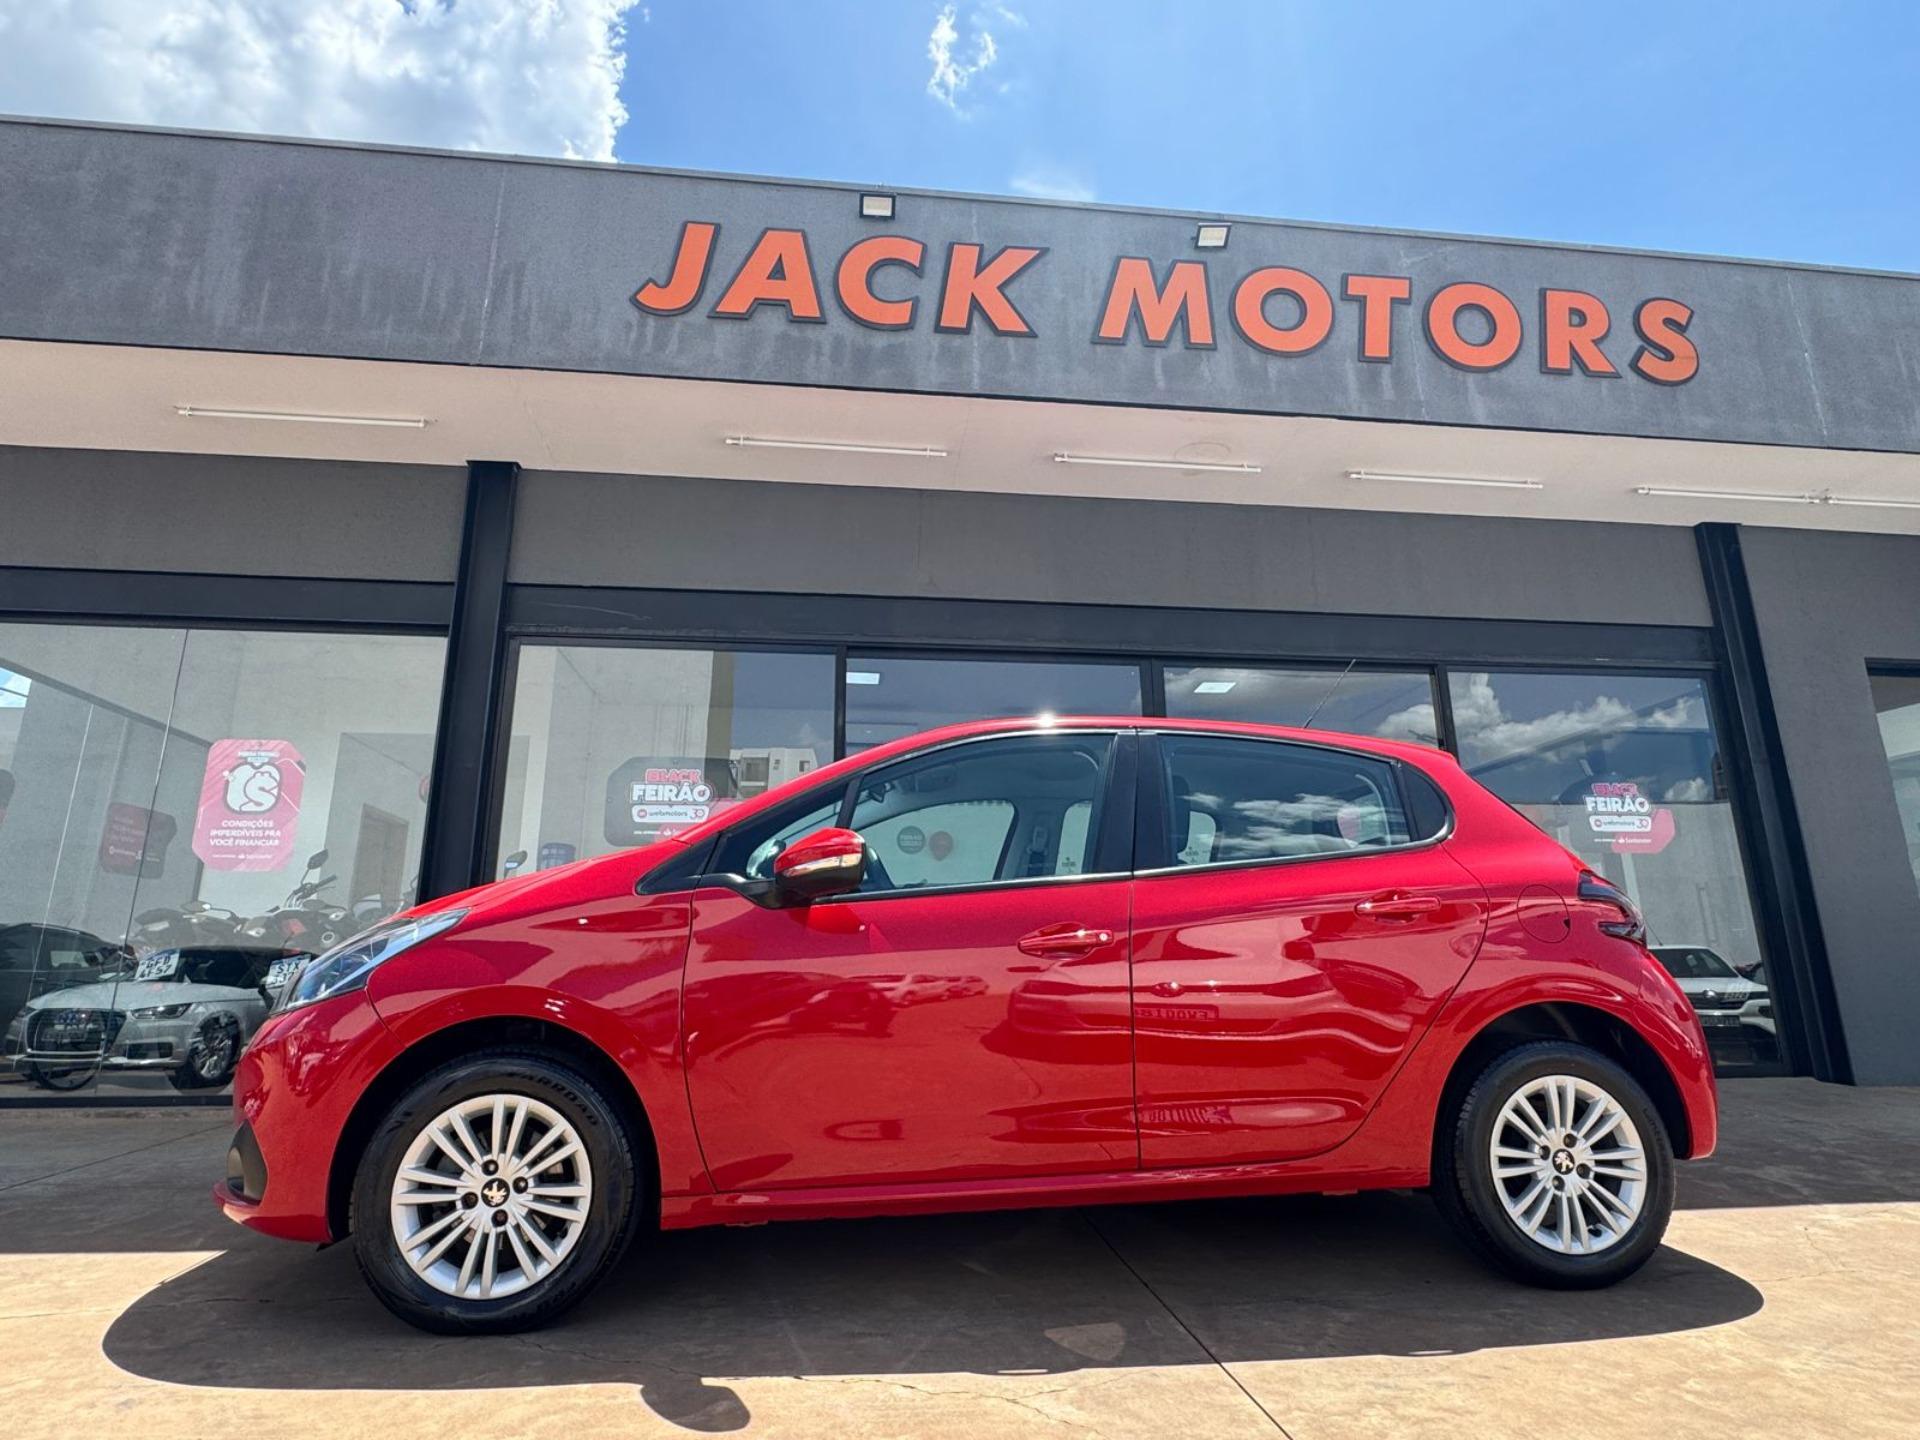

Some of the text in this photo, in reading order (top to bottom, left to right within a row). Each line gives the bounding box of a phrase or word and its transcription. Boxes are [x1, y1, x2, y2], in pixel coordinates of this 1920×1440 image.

[631, 220, 1700, 387] JACK MOTORS
[645, 768, 700, 784] BLACK
[632, 783, 711, 802] FEIRÃO
[1585, 795, 1649, 813] FEIRÃO
[649, 808, 688, 817] webmotors
[222, 818, 274, 829] CONDIÇÕES
[210, 828, 282, 838] IMPERDÍVEIS PRA
[210, 837, 280, 847] VOCÊ FINANCIAR
